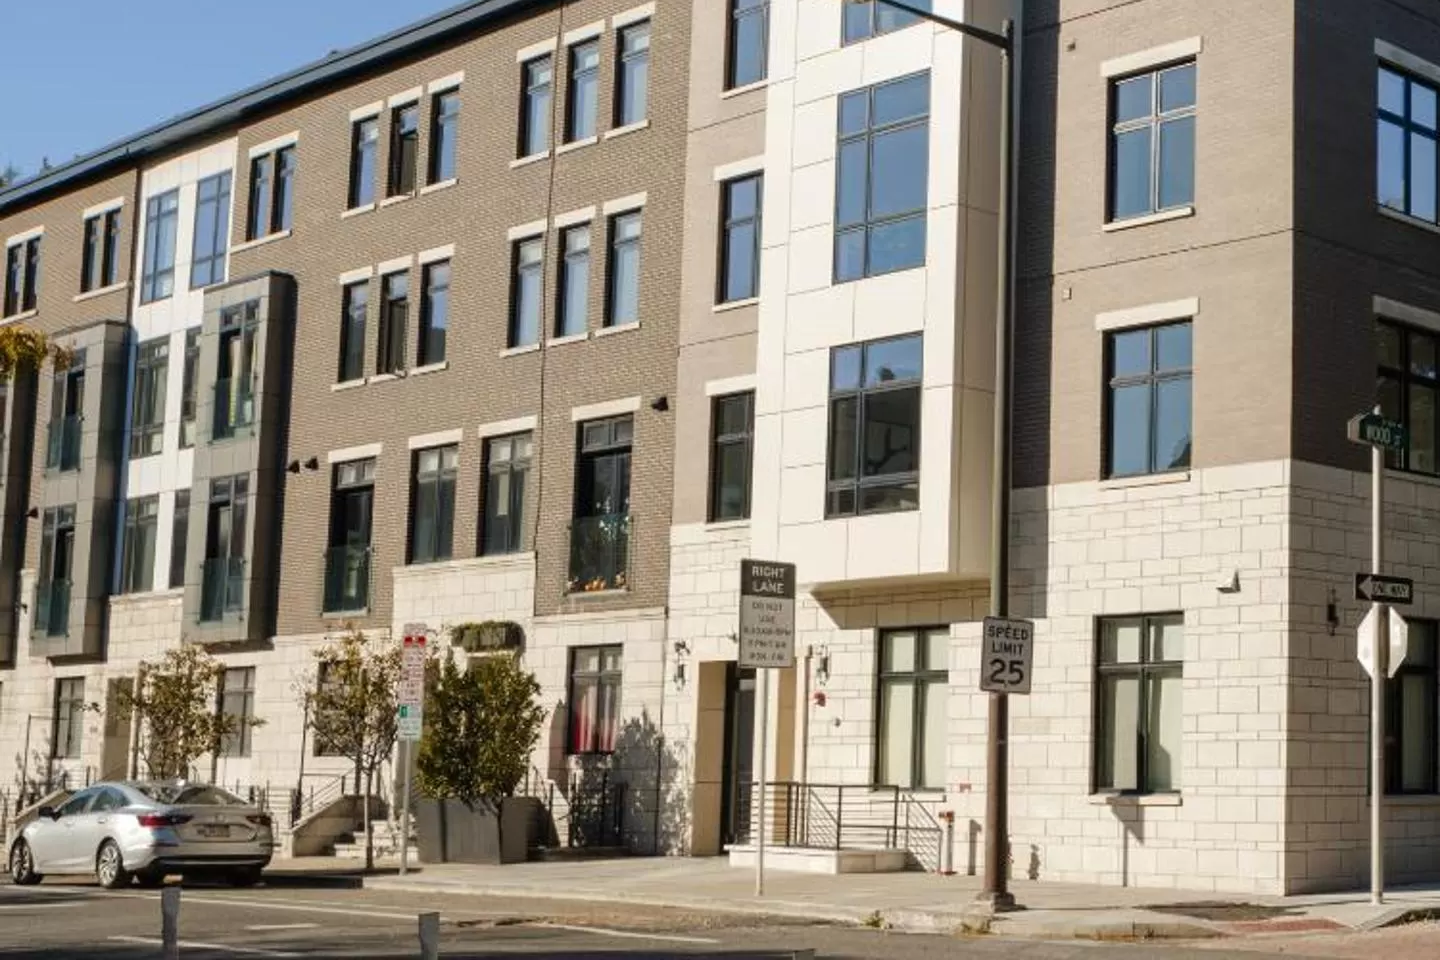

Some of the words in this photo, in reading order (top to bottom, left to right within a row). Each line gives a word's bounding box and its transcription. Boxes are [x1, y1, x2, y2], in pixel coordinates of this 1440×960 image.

[752, 565, 785, 579] RIGHT
[752, 580, 785, 594] LANE
[987, 625, 1029, 641] SPEED
[991, 640, 1024, 656] LIMIT
[989, 658, 1025, 686] 25
